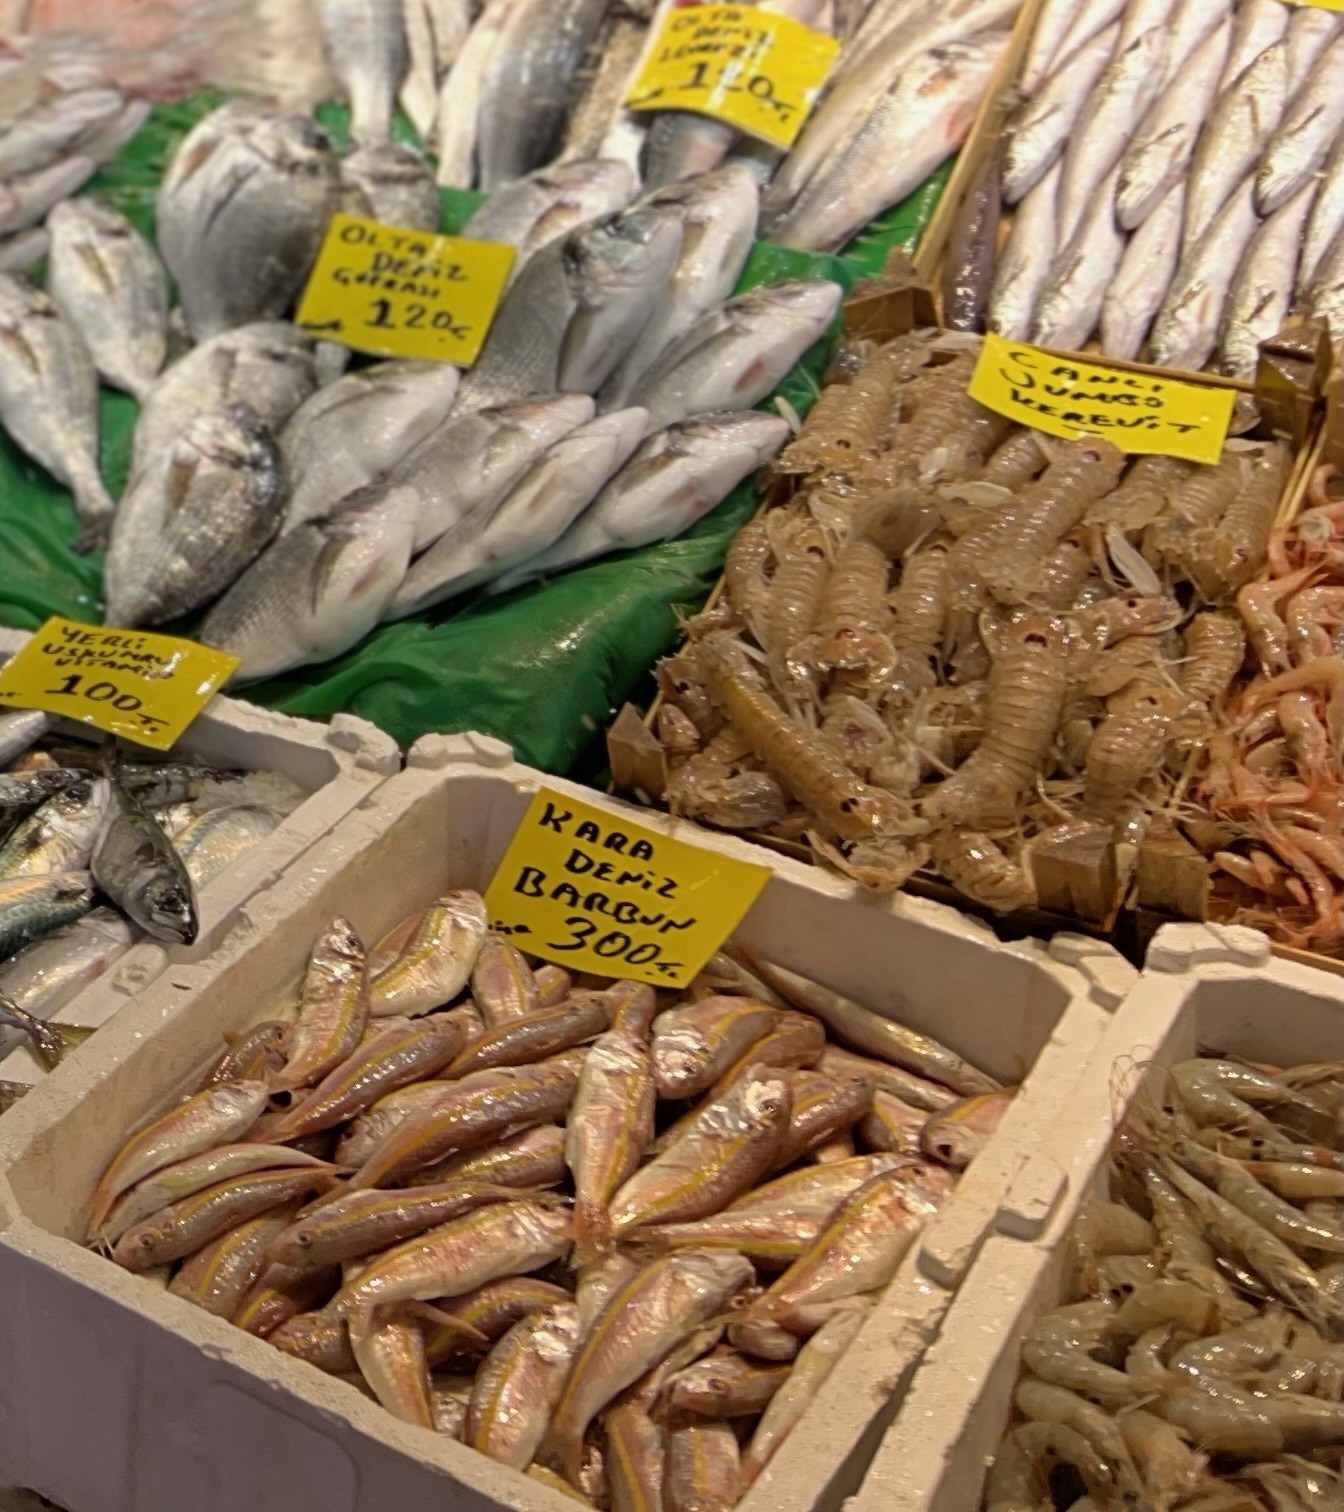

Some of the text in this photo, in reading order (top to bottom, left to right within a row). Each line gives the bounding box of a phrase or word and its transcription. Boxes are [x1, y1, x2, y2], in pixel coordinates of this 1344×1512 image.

[538, 801, 655, 862] KARA
[512, 865, 698, 935] BARBUN
[563, 847, 680, 900] DENİZ
